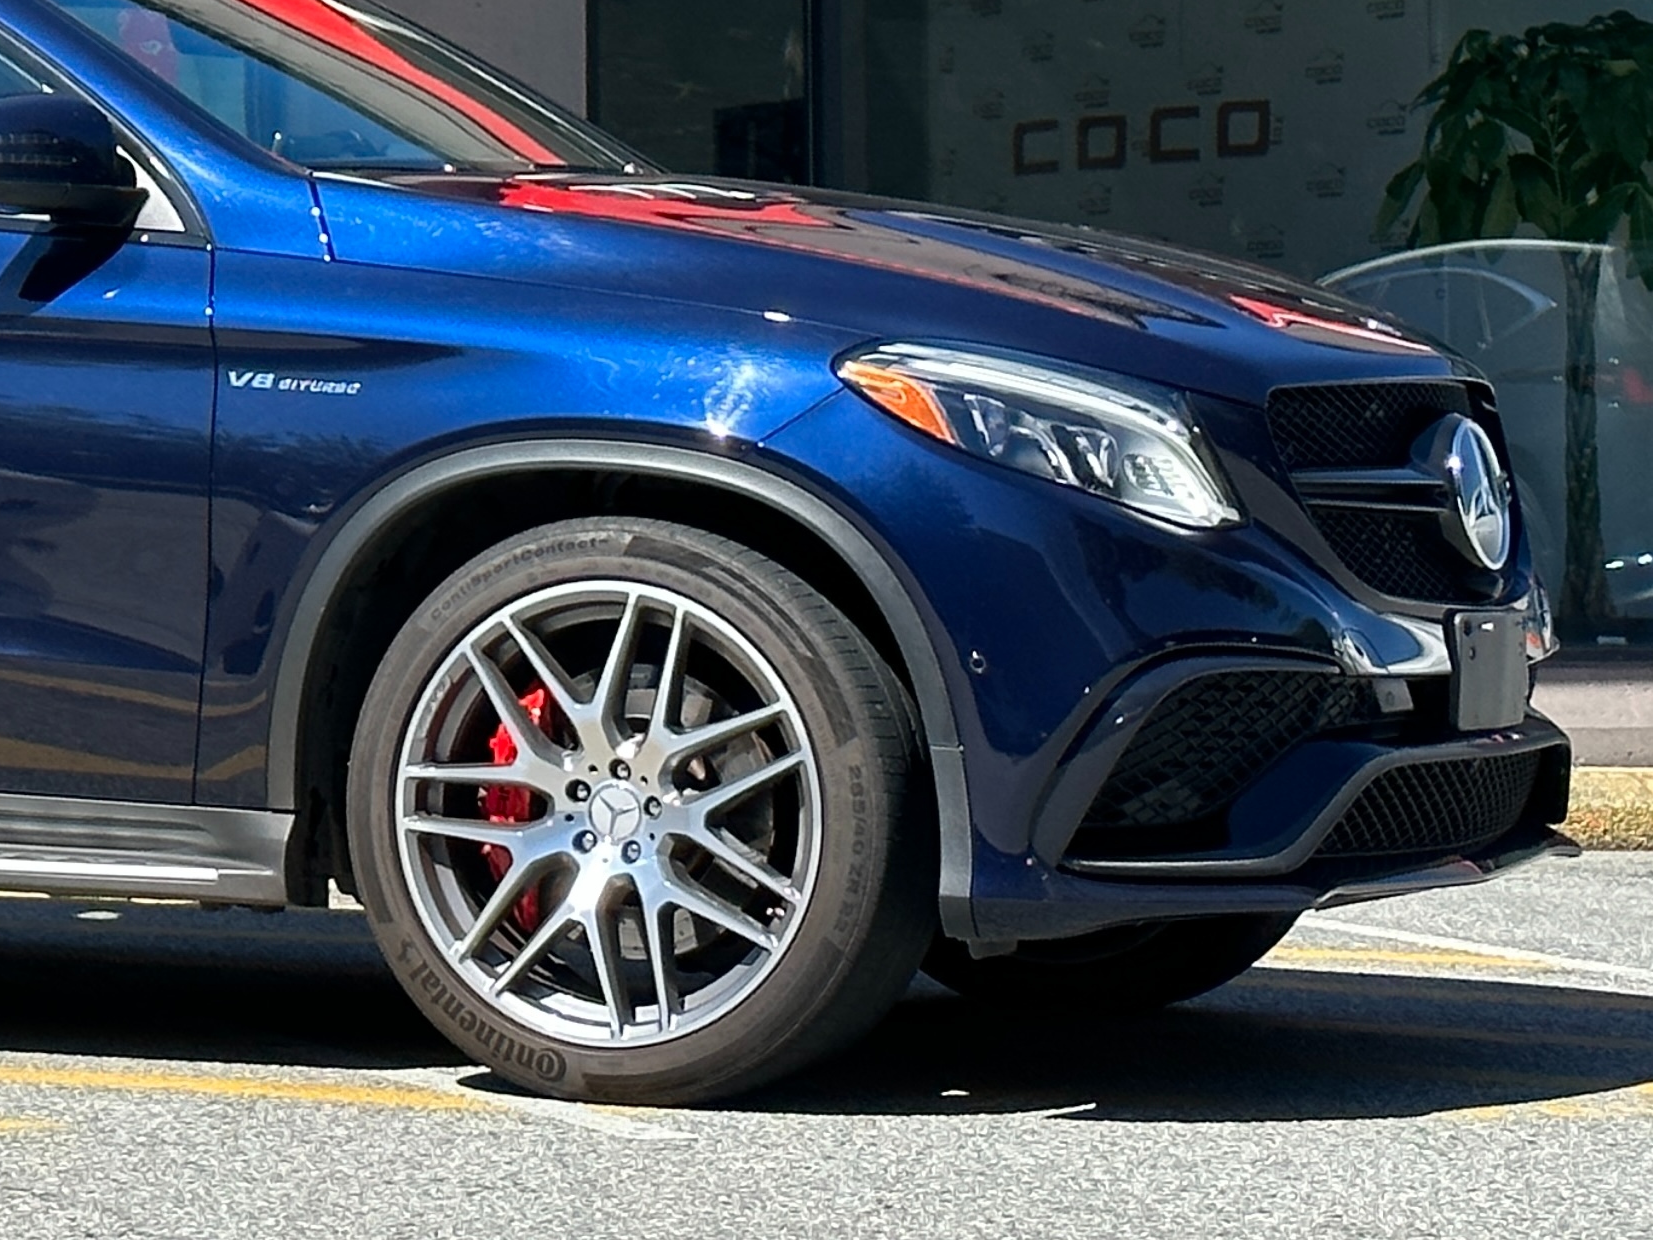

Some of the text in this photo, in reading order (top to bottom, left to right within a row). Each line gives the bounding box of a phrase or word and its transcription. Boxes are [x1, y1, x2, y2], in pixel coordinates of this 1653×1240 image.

[1012, 98, 1271, 176] COCO
[228, 370, 276, 389] V8
[408, 959, 568, 1083] Continental
